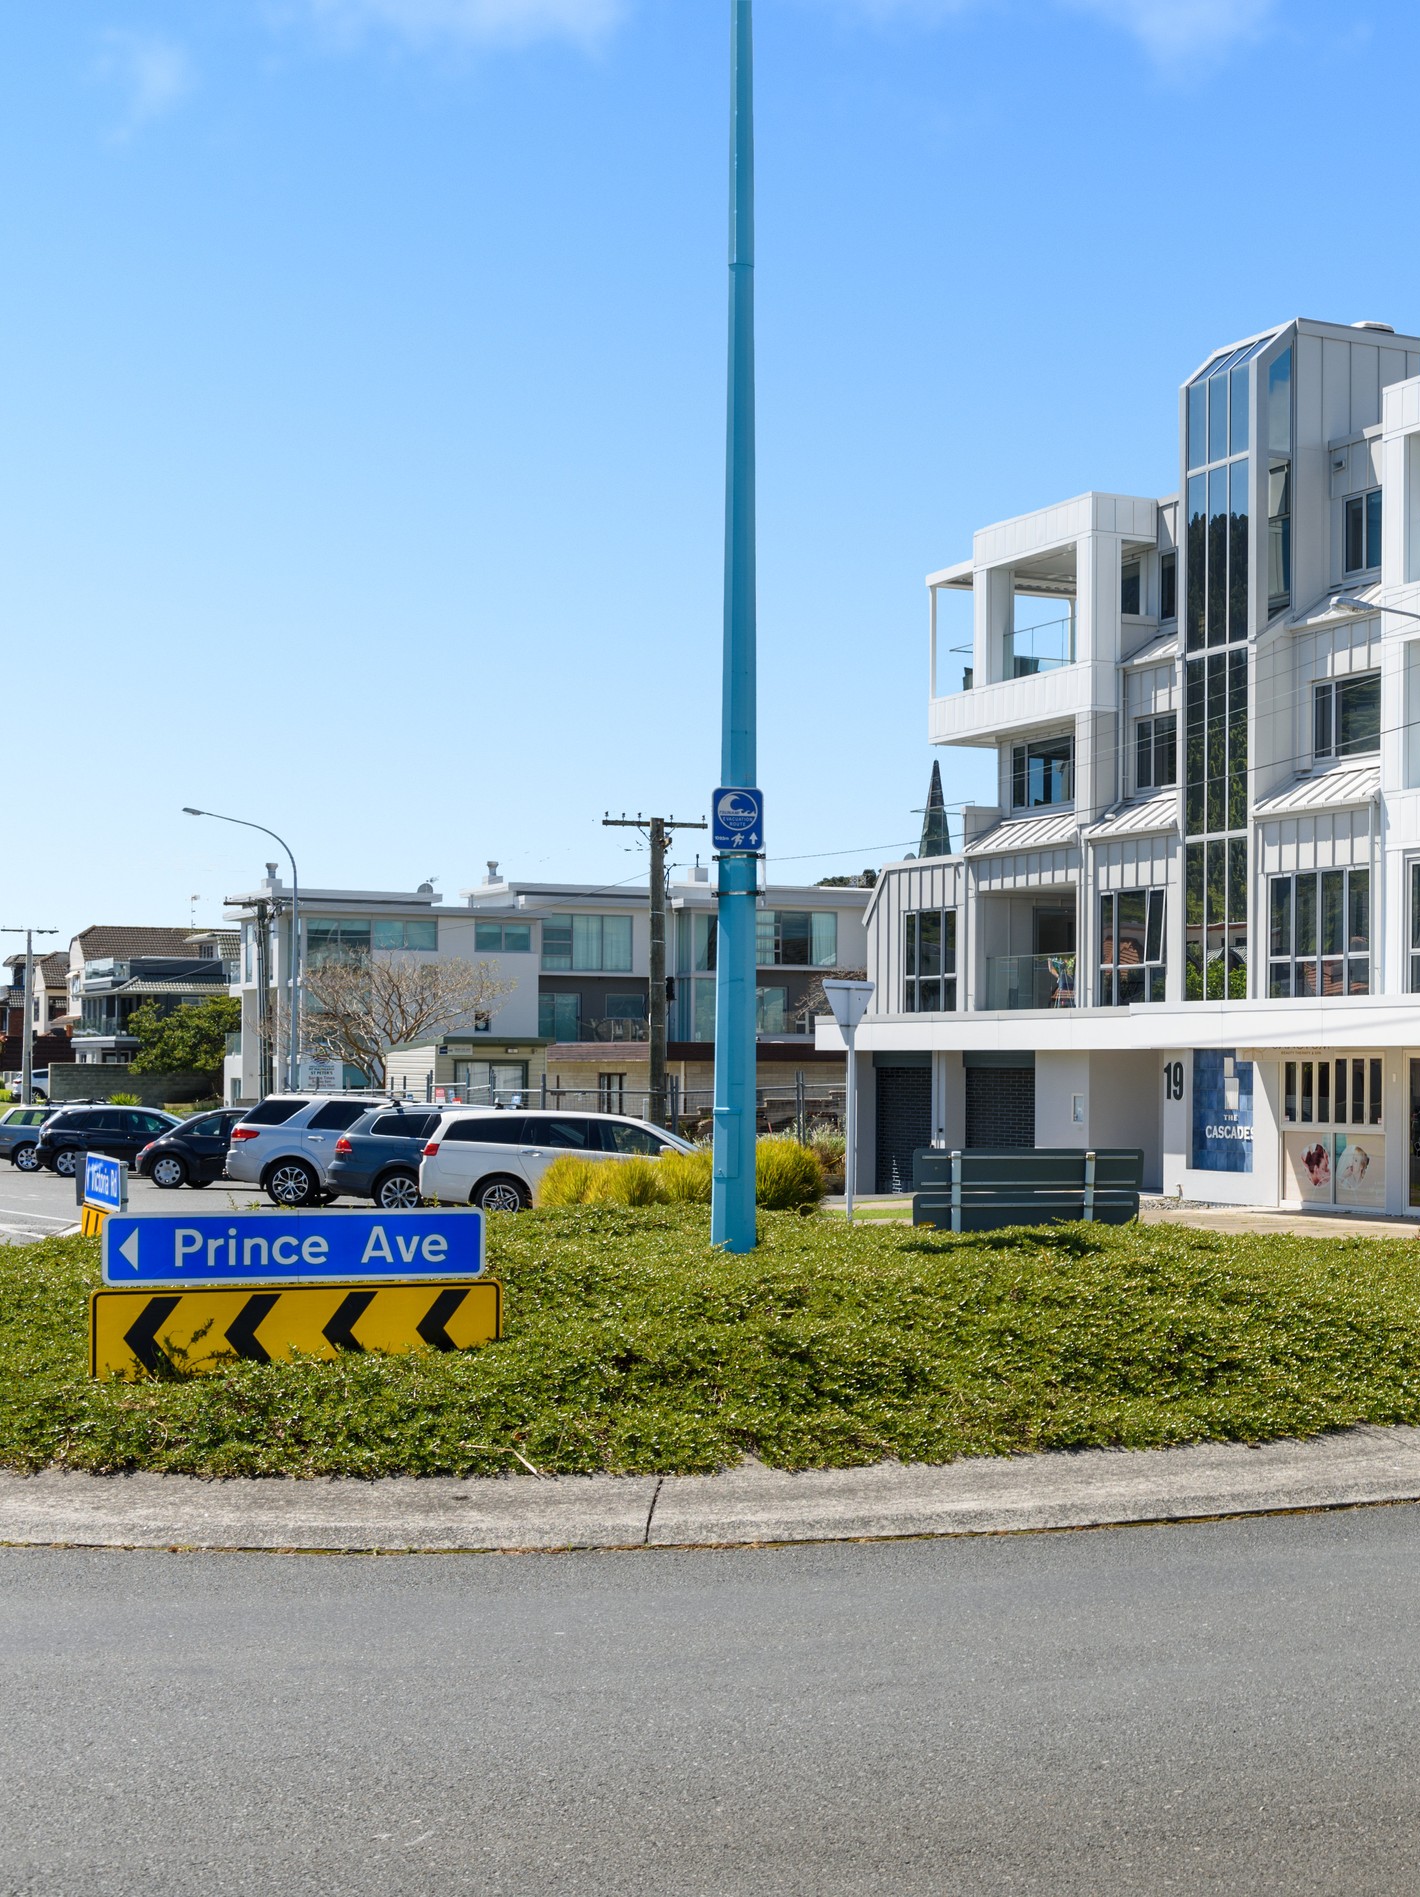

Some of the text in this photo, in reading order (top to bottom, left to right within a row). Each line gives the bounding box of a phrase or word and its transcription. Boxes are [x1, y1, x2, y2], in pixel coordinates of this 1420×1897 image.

[1164, 1061, 1184, 1101] 19
[91, 1165, 118, 1198] Victoria Rd
[174, 1225, 448, 1267] Prince Ave
